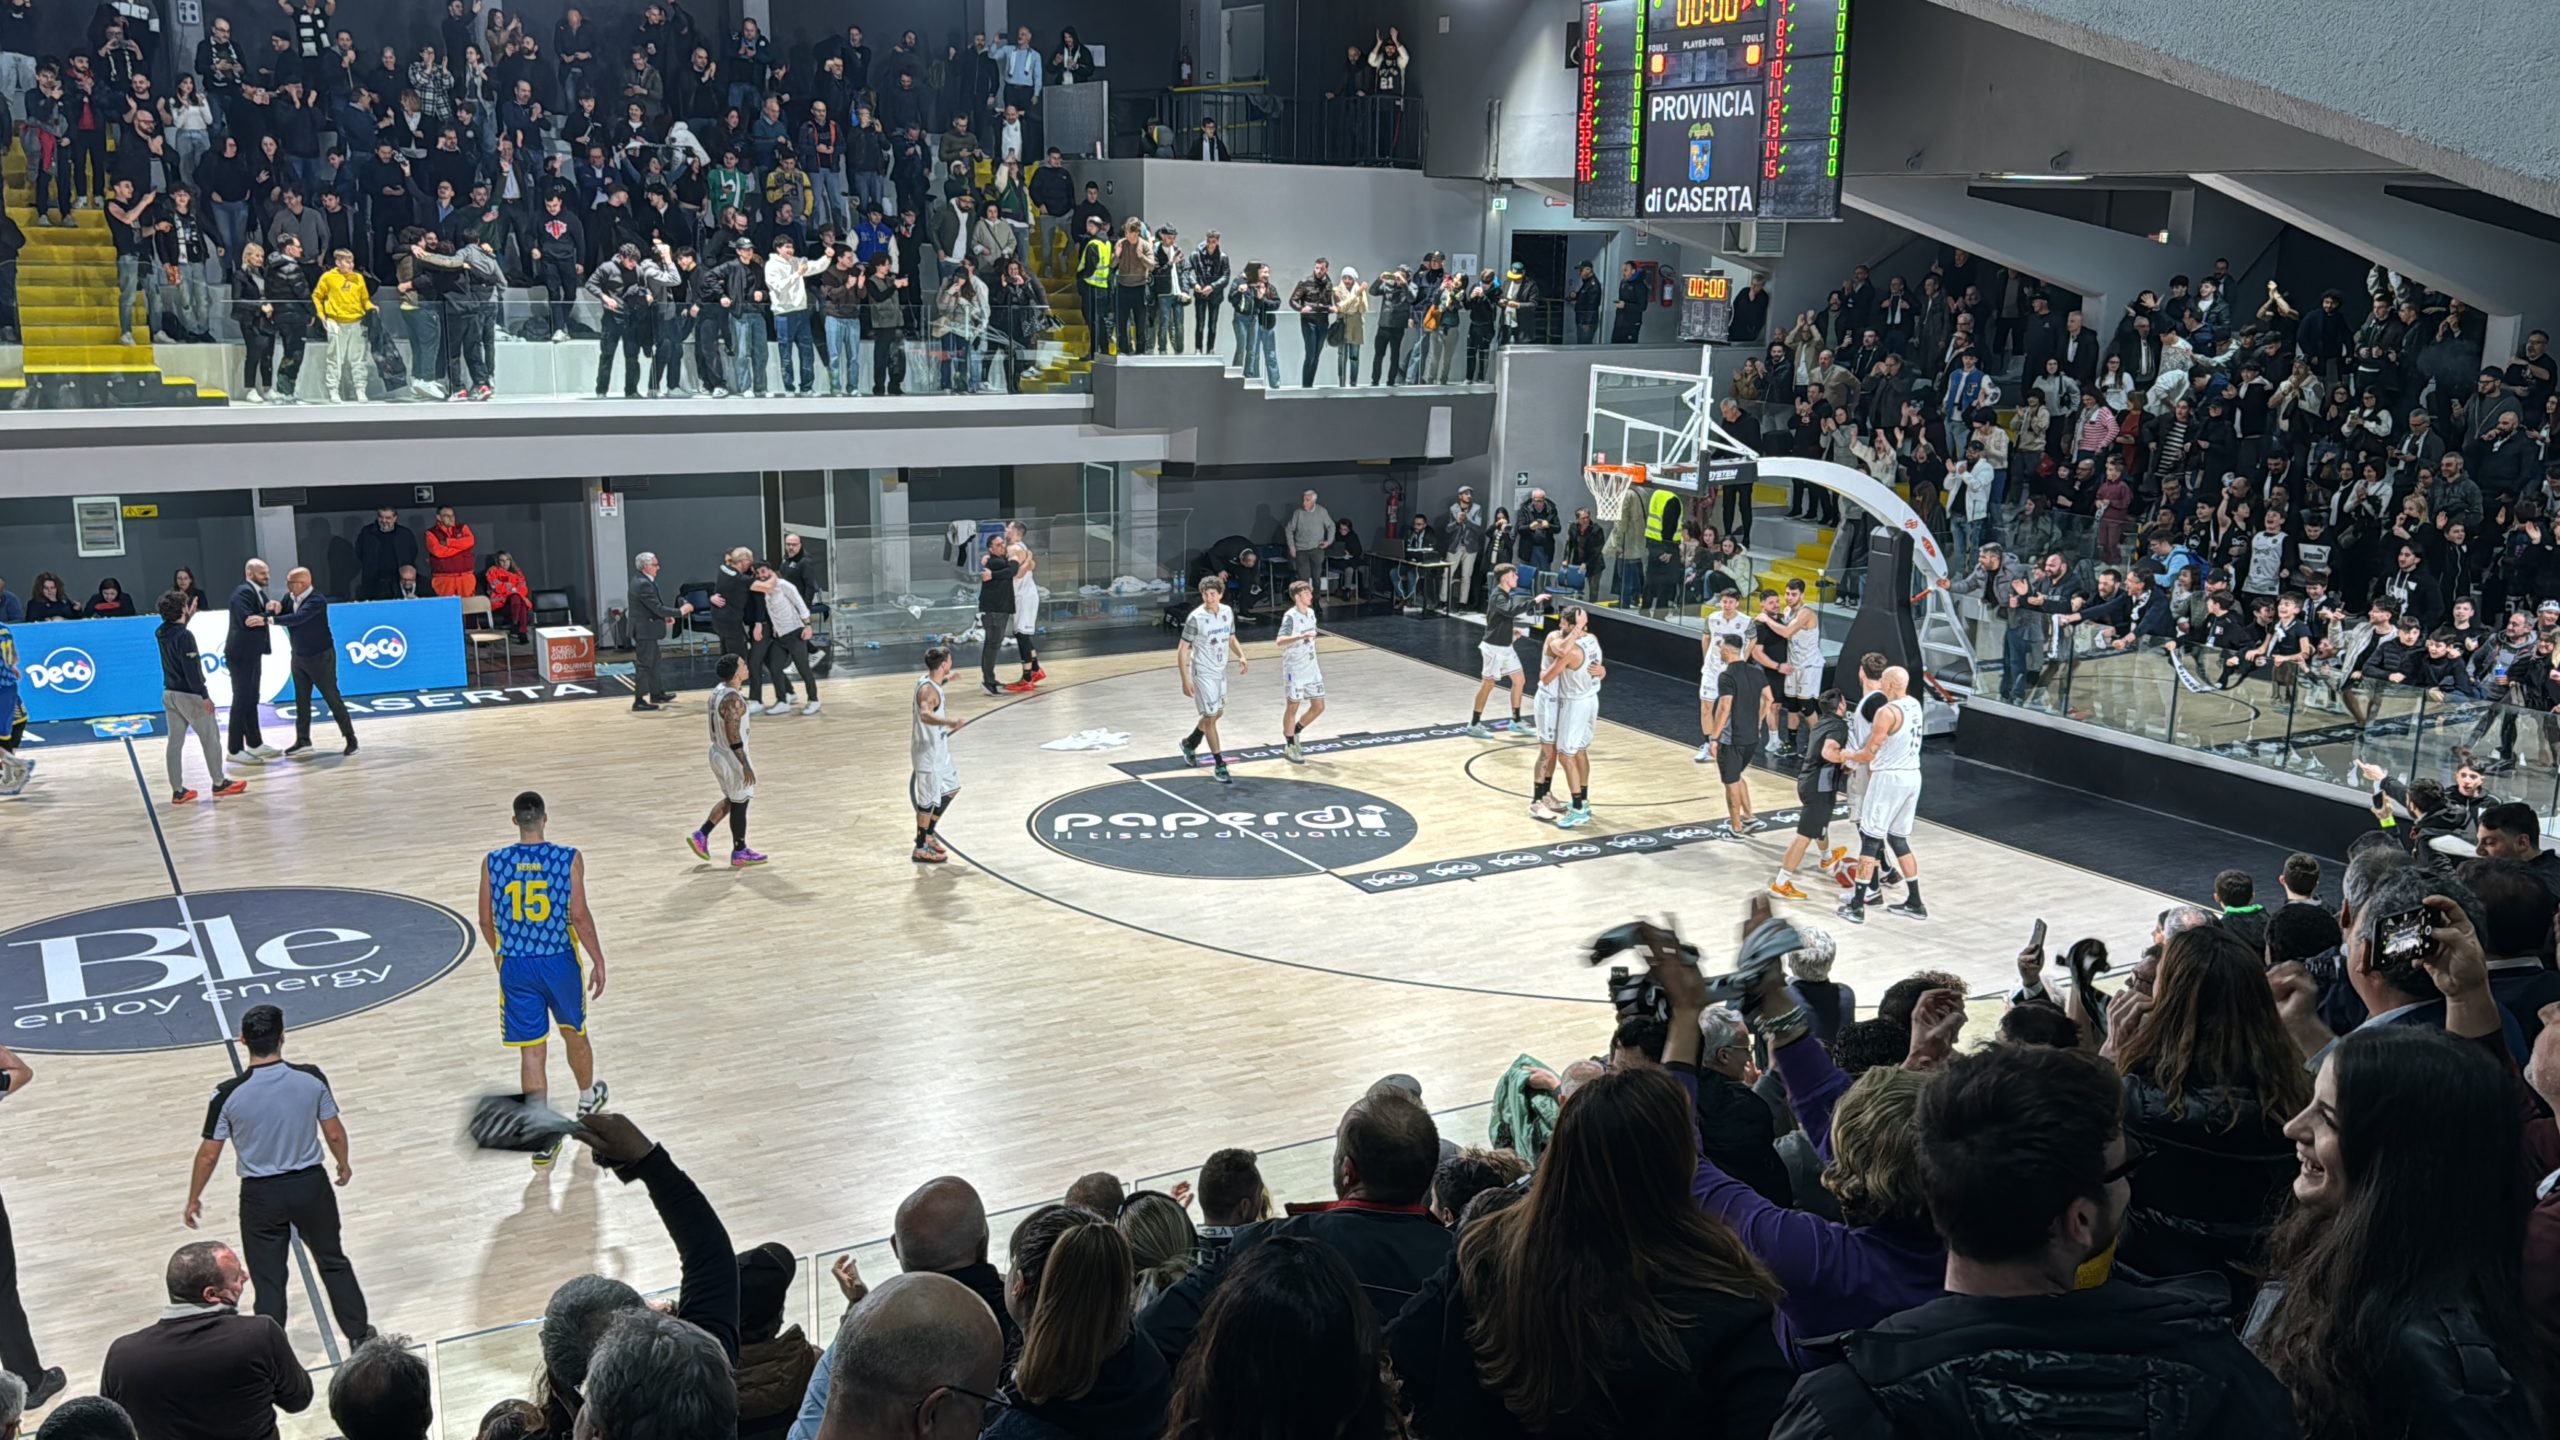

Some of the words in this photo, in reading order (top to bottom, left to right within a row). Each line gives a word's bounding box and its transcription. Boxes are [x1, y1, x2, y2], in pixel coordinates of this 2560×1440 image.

[1648, 43, 1668, 53] FOULS
[1682, 37, 1725, 49] PLAYER-FOUL
[1742, 33, 1765, 43] FOULS
[1651, 90, 1755, 122] PROVINCIA
[1645, 187, 1661, 212] di
[1665, 186, 1753, 212] CASERTA
[1688, 278, 1726, 298] 00:00
[275, 683, 597, 719] CASERTA
[1343, 732, 1427, 746] Designer
[1054, 805, 1387, 832] paperdi
[1088, 831, 1200, 840] tissue
[504, 880, 551, 922] 15
[8, 915, 381, 1010] Ble
[14, 994, 182, 1029] enjoy
[201, 964, 392, 1002] energy
